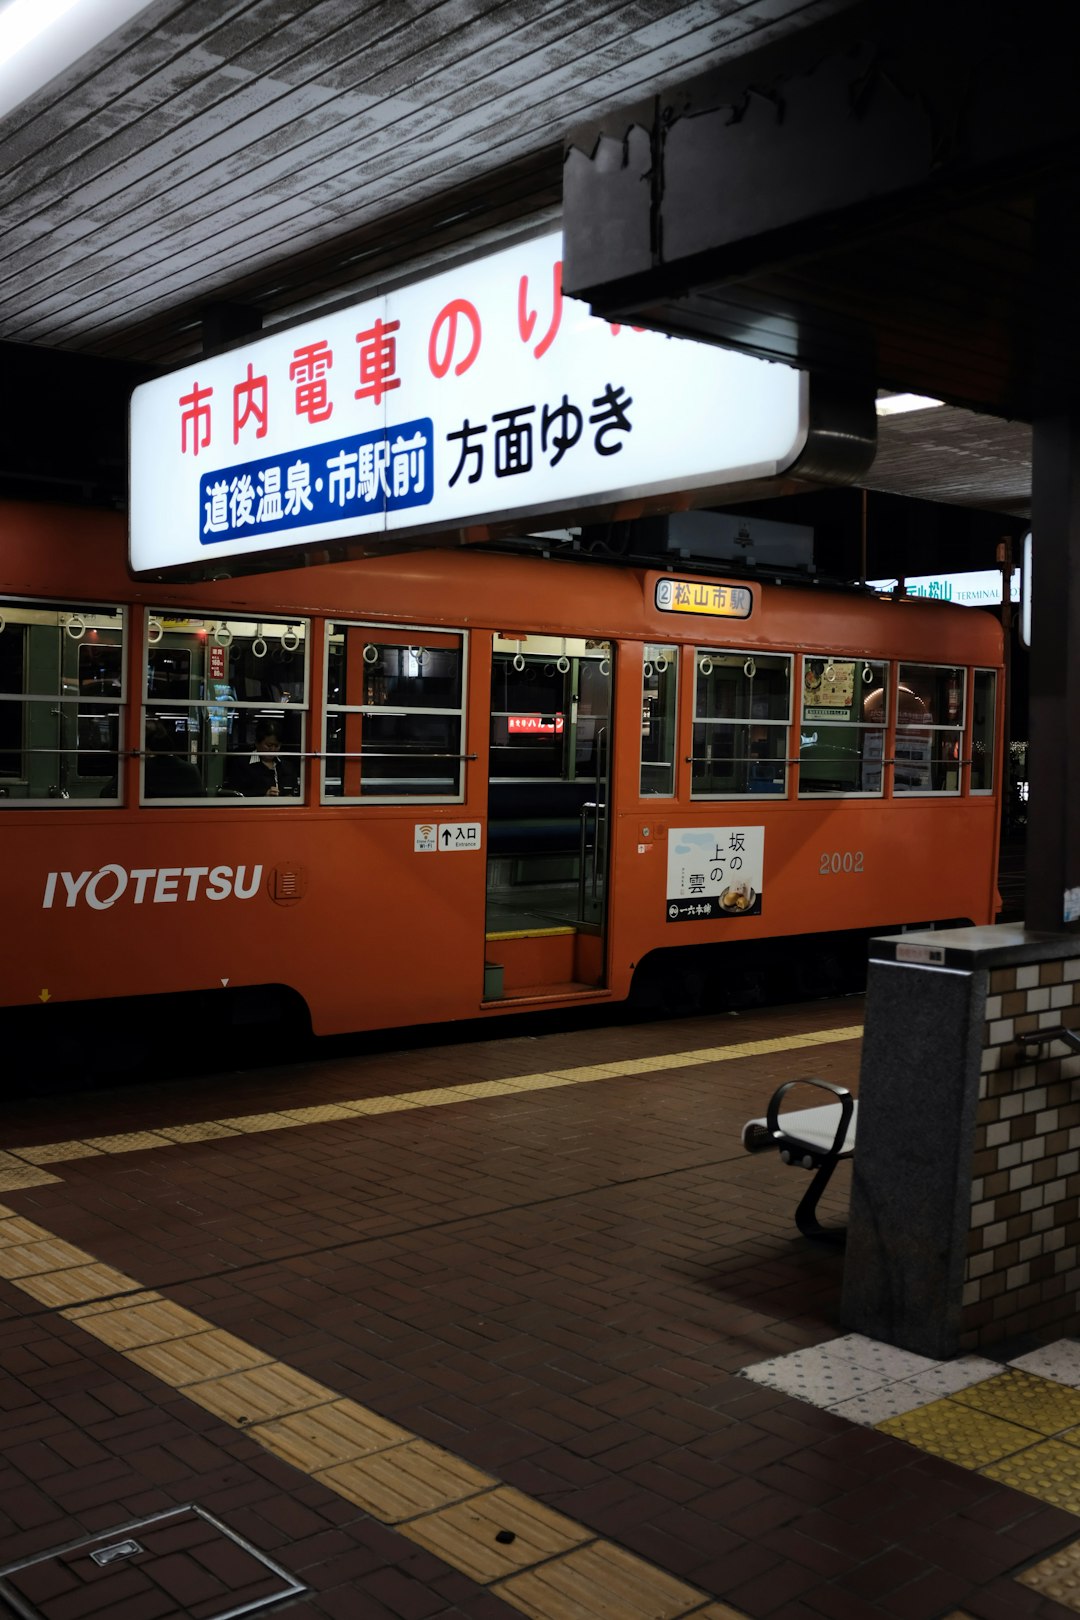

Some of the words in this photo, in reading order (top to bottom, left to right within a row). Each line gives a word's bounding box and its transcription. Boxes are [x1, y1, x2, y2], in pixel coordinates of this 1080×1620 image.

[178, 259, 648, 457] 市内電車のり
[446, 383, 633, 489] 方面ゆき
[660, 586, 670, 601] 2
[674, 583, 746, 610] 松山市駅
[956, 589, 1000, 601] TERMINAL
[455, 827, 476, 840] 入口
[709, 844, 726, 882] 上の
[728, 832, 746, 871] 坂の
[819, 851, 865, 875] 2002
[42, 863, 263, 910] IYOTETSU
[688, 874, 706, 893] 雲
